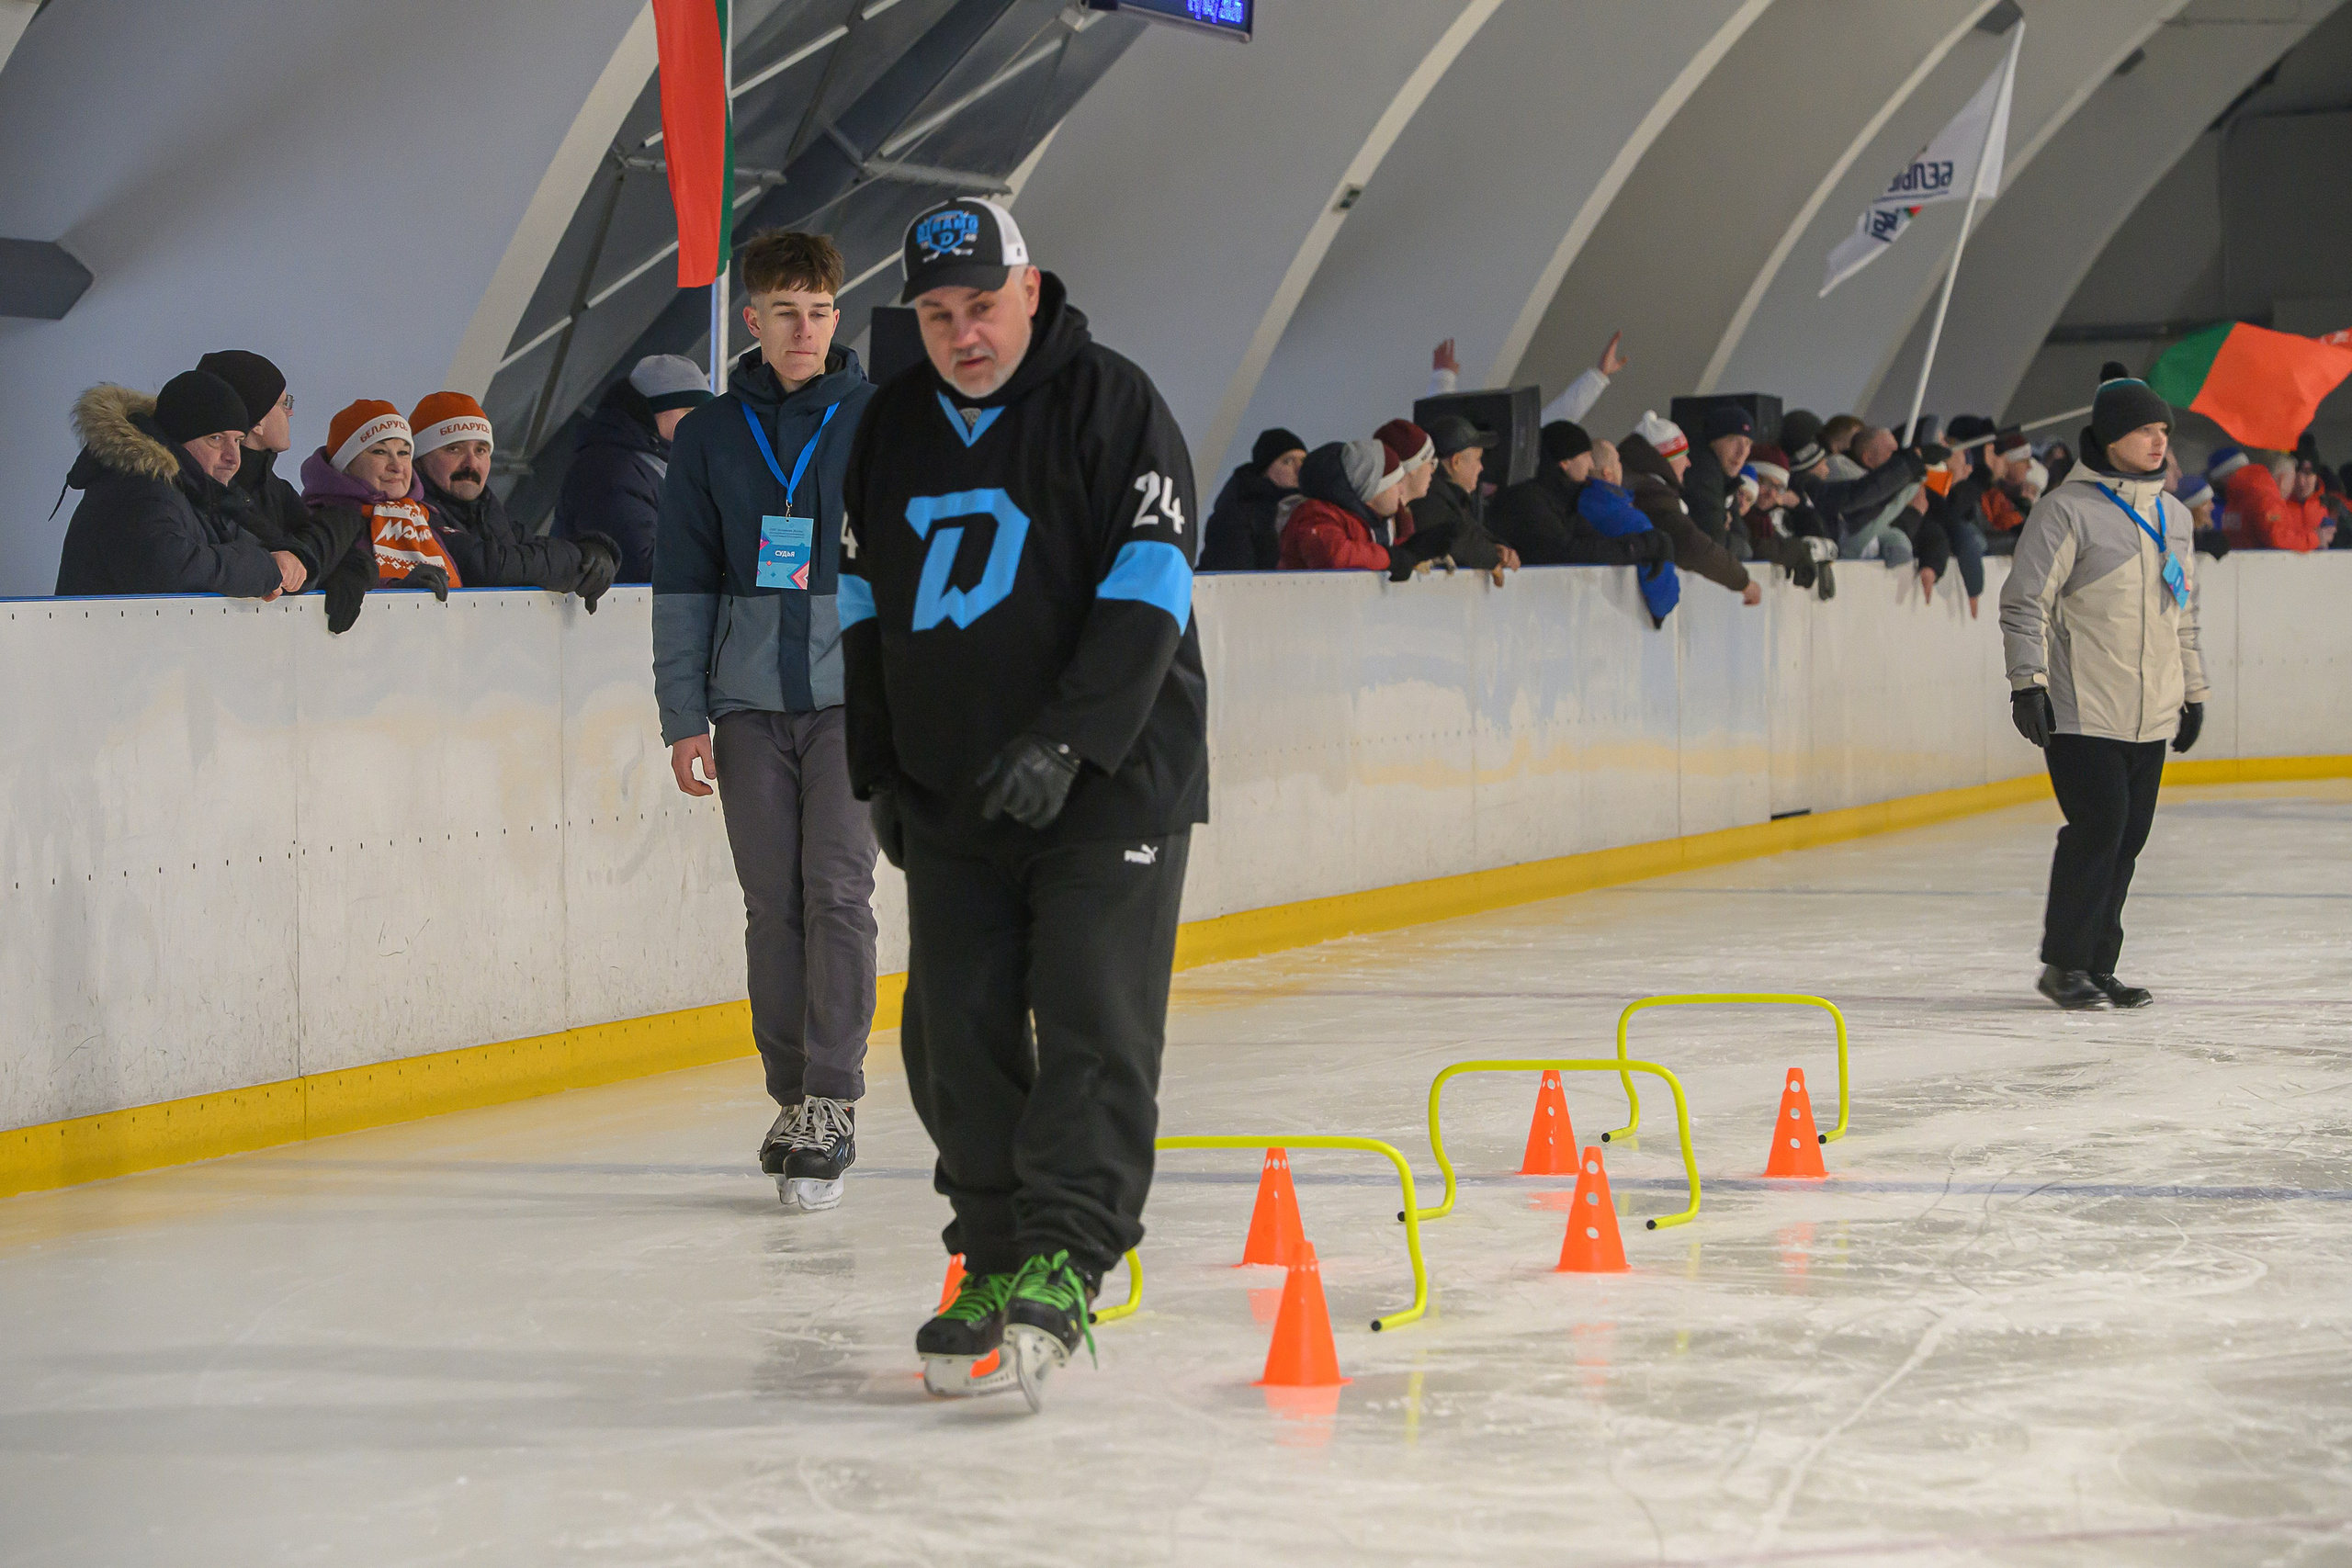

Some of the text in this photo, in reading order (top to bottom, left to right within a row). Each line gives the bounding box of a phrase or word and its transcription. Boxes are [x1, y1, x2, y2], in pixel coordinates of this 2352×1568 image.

[360, 420, 409, 444] БЕЛАРУСЬ
[439, 422, 490, 436] БЕЛАРУСЬ
[1133, 470, 1185, 535] 24
[775, 549, 796, 558] СУДЬЯ
[904, 487, 1031, 632] D
